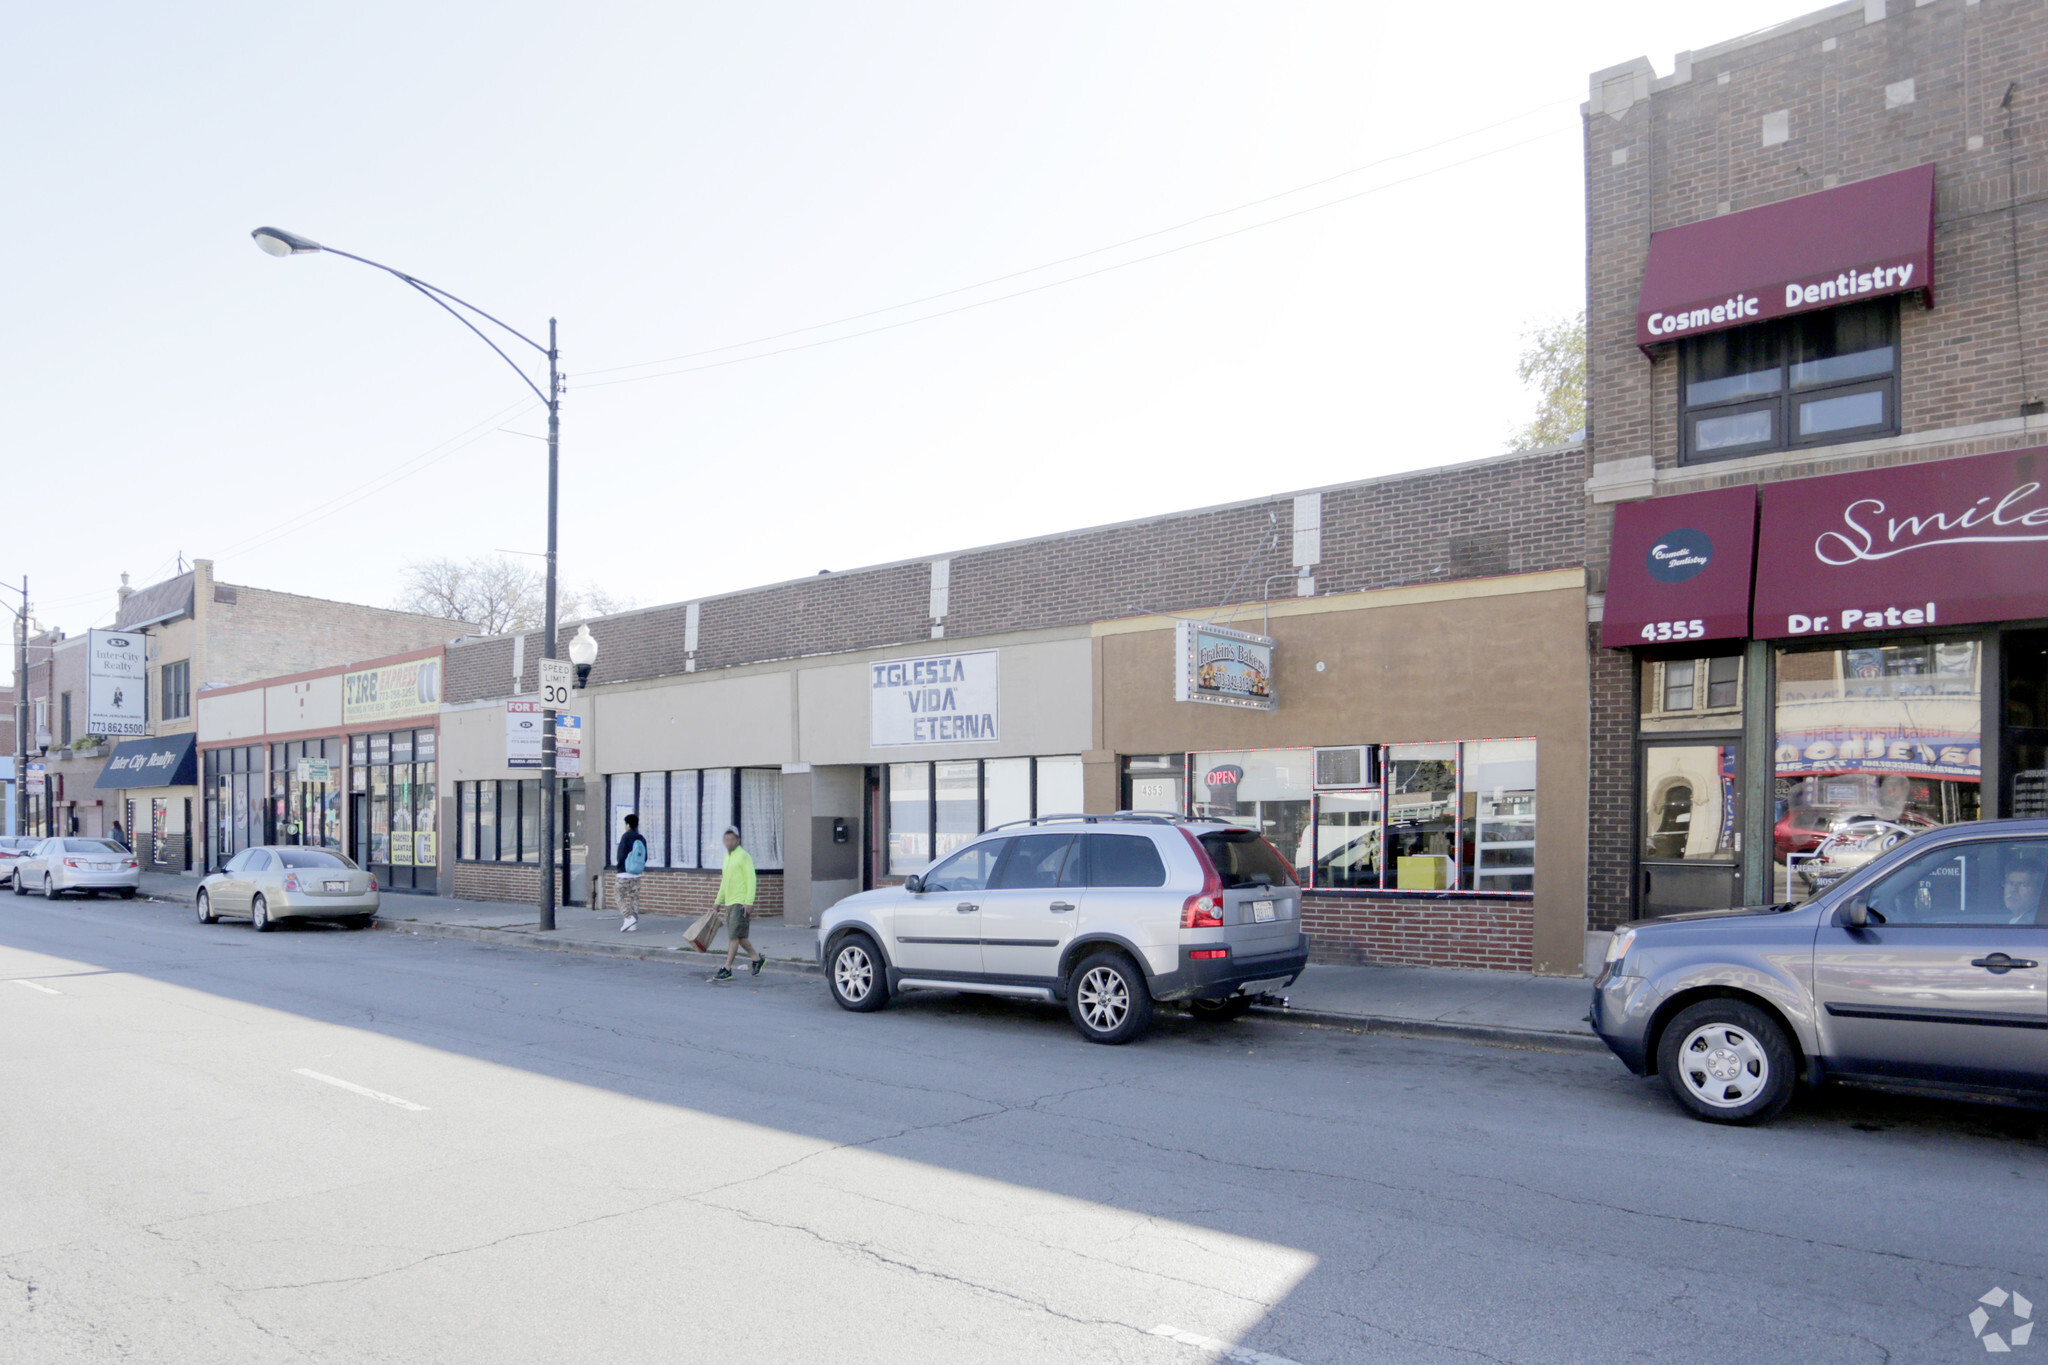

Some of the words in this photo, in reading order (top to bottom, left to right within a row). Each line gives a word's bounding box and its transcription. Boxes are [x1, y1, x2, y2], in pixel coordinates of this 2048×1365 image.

[1646, 293, 1759, 336] Cosmetic
[1785, 262, 1914, 308] Dentistry
[1652, 544, 1690, 560] Cosmetic
[1668, 555, 1708, 569] Dentistry
[1787, 613, 1830, 634] Dr.
[1841, 602, 1936, 629] Patel
[1640, 619, 1705, 641] 4355
[96, 650, 140, 662] Inter-City
[104, 661, 132, 672] Realty
[543, 664, 570, 674] SPEED
[873, 658, 965, 688] IGLESIA
[346, 672, 378, 705] TIRE
[380, 664, 418, 691] EXPRESS
[545, 675, 566, 683] LIMIT
[544, 685, 568, 704] 30
[508, 703, 530, 711] FOR
[91, 722, 106, 732] 773
[107, 722, 122, 733] 862
[124, 723, 143, 734] 5500
[913, 714, 995, 741] ETERNA
[1804, 729, 1843, 742] FREE
[1848, 722, 1951, 742] Consultation
[109, 756, 130, 770] Inter
[129, 754, 148, 771] City
[1207, 769, 1238, 786] OPEN
[1142, 785, 1163, 796] 4353
